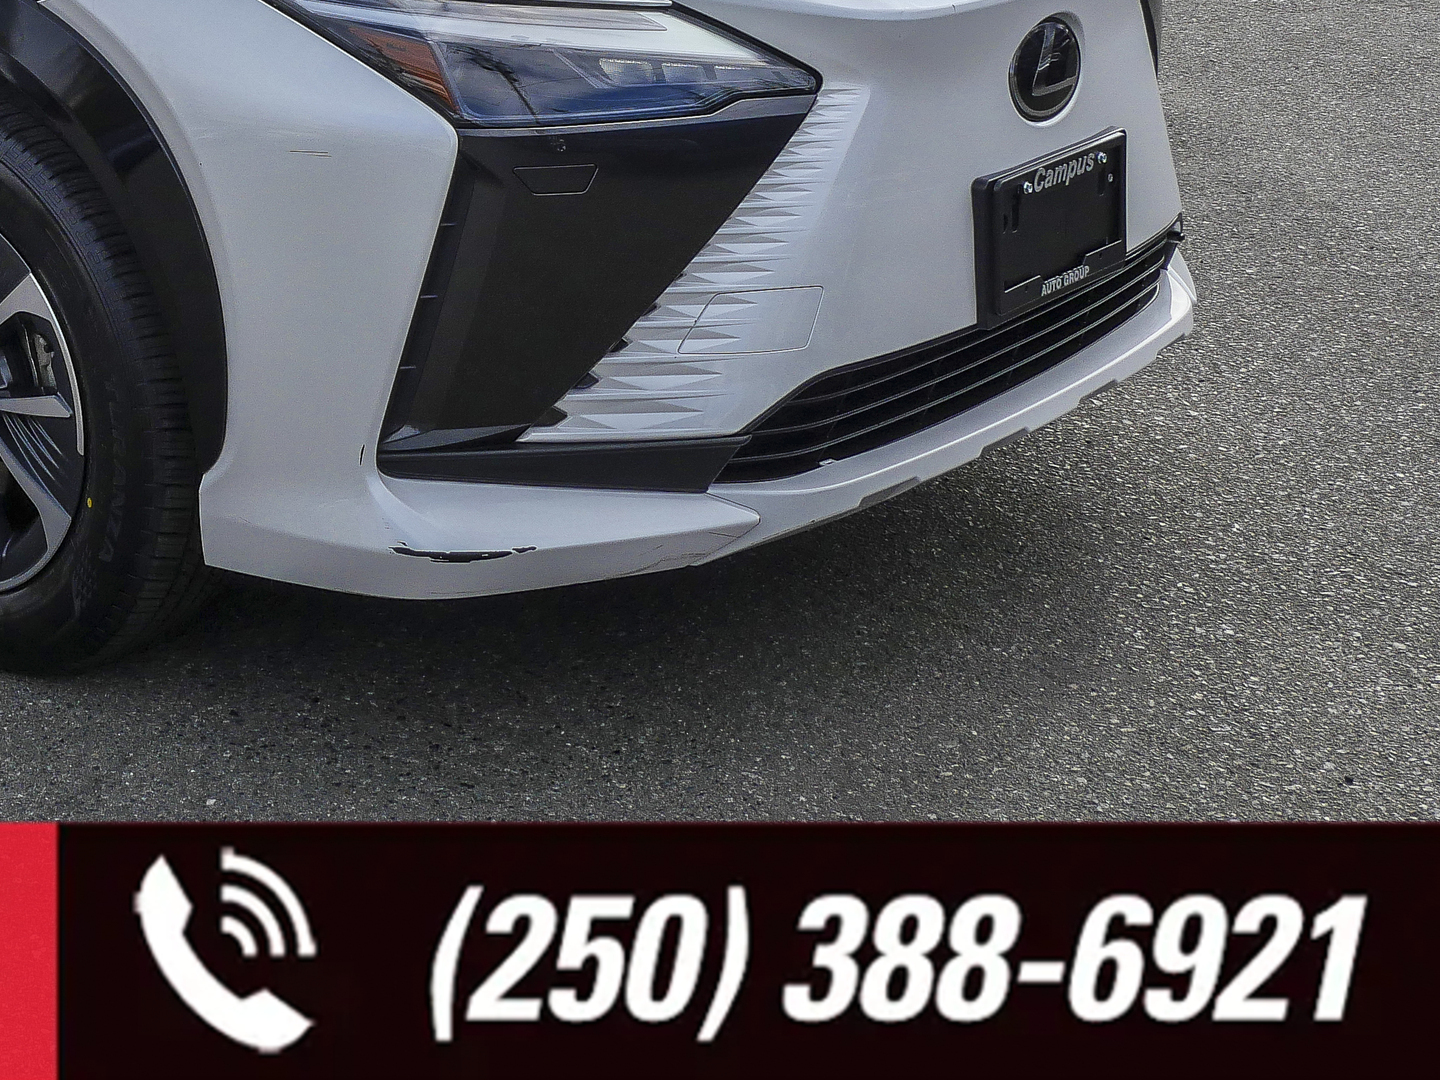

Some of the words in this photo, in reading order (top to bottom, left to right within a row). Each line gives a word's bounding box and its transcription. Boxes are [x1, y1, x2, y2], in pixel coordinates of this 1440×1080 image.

[1033, 152, 1095, 194] Campus
[1041, 275, 1062, 297] AUTO
[1063, 265, 1090, 287] GROUP
